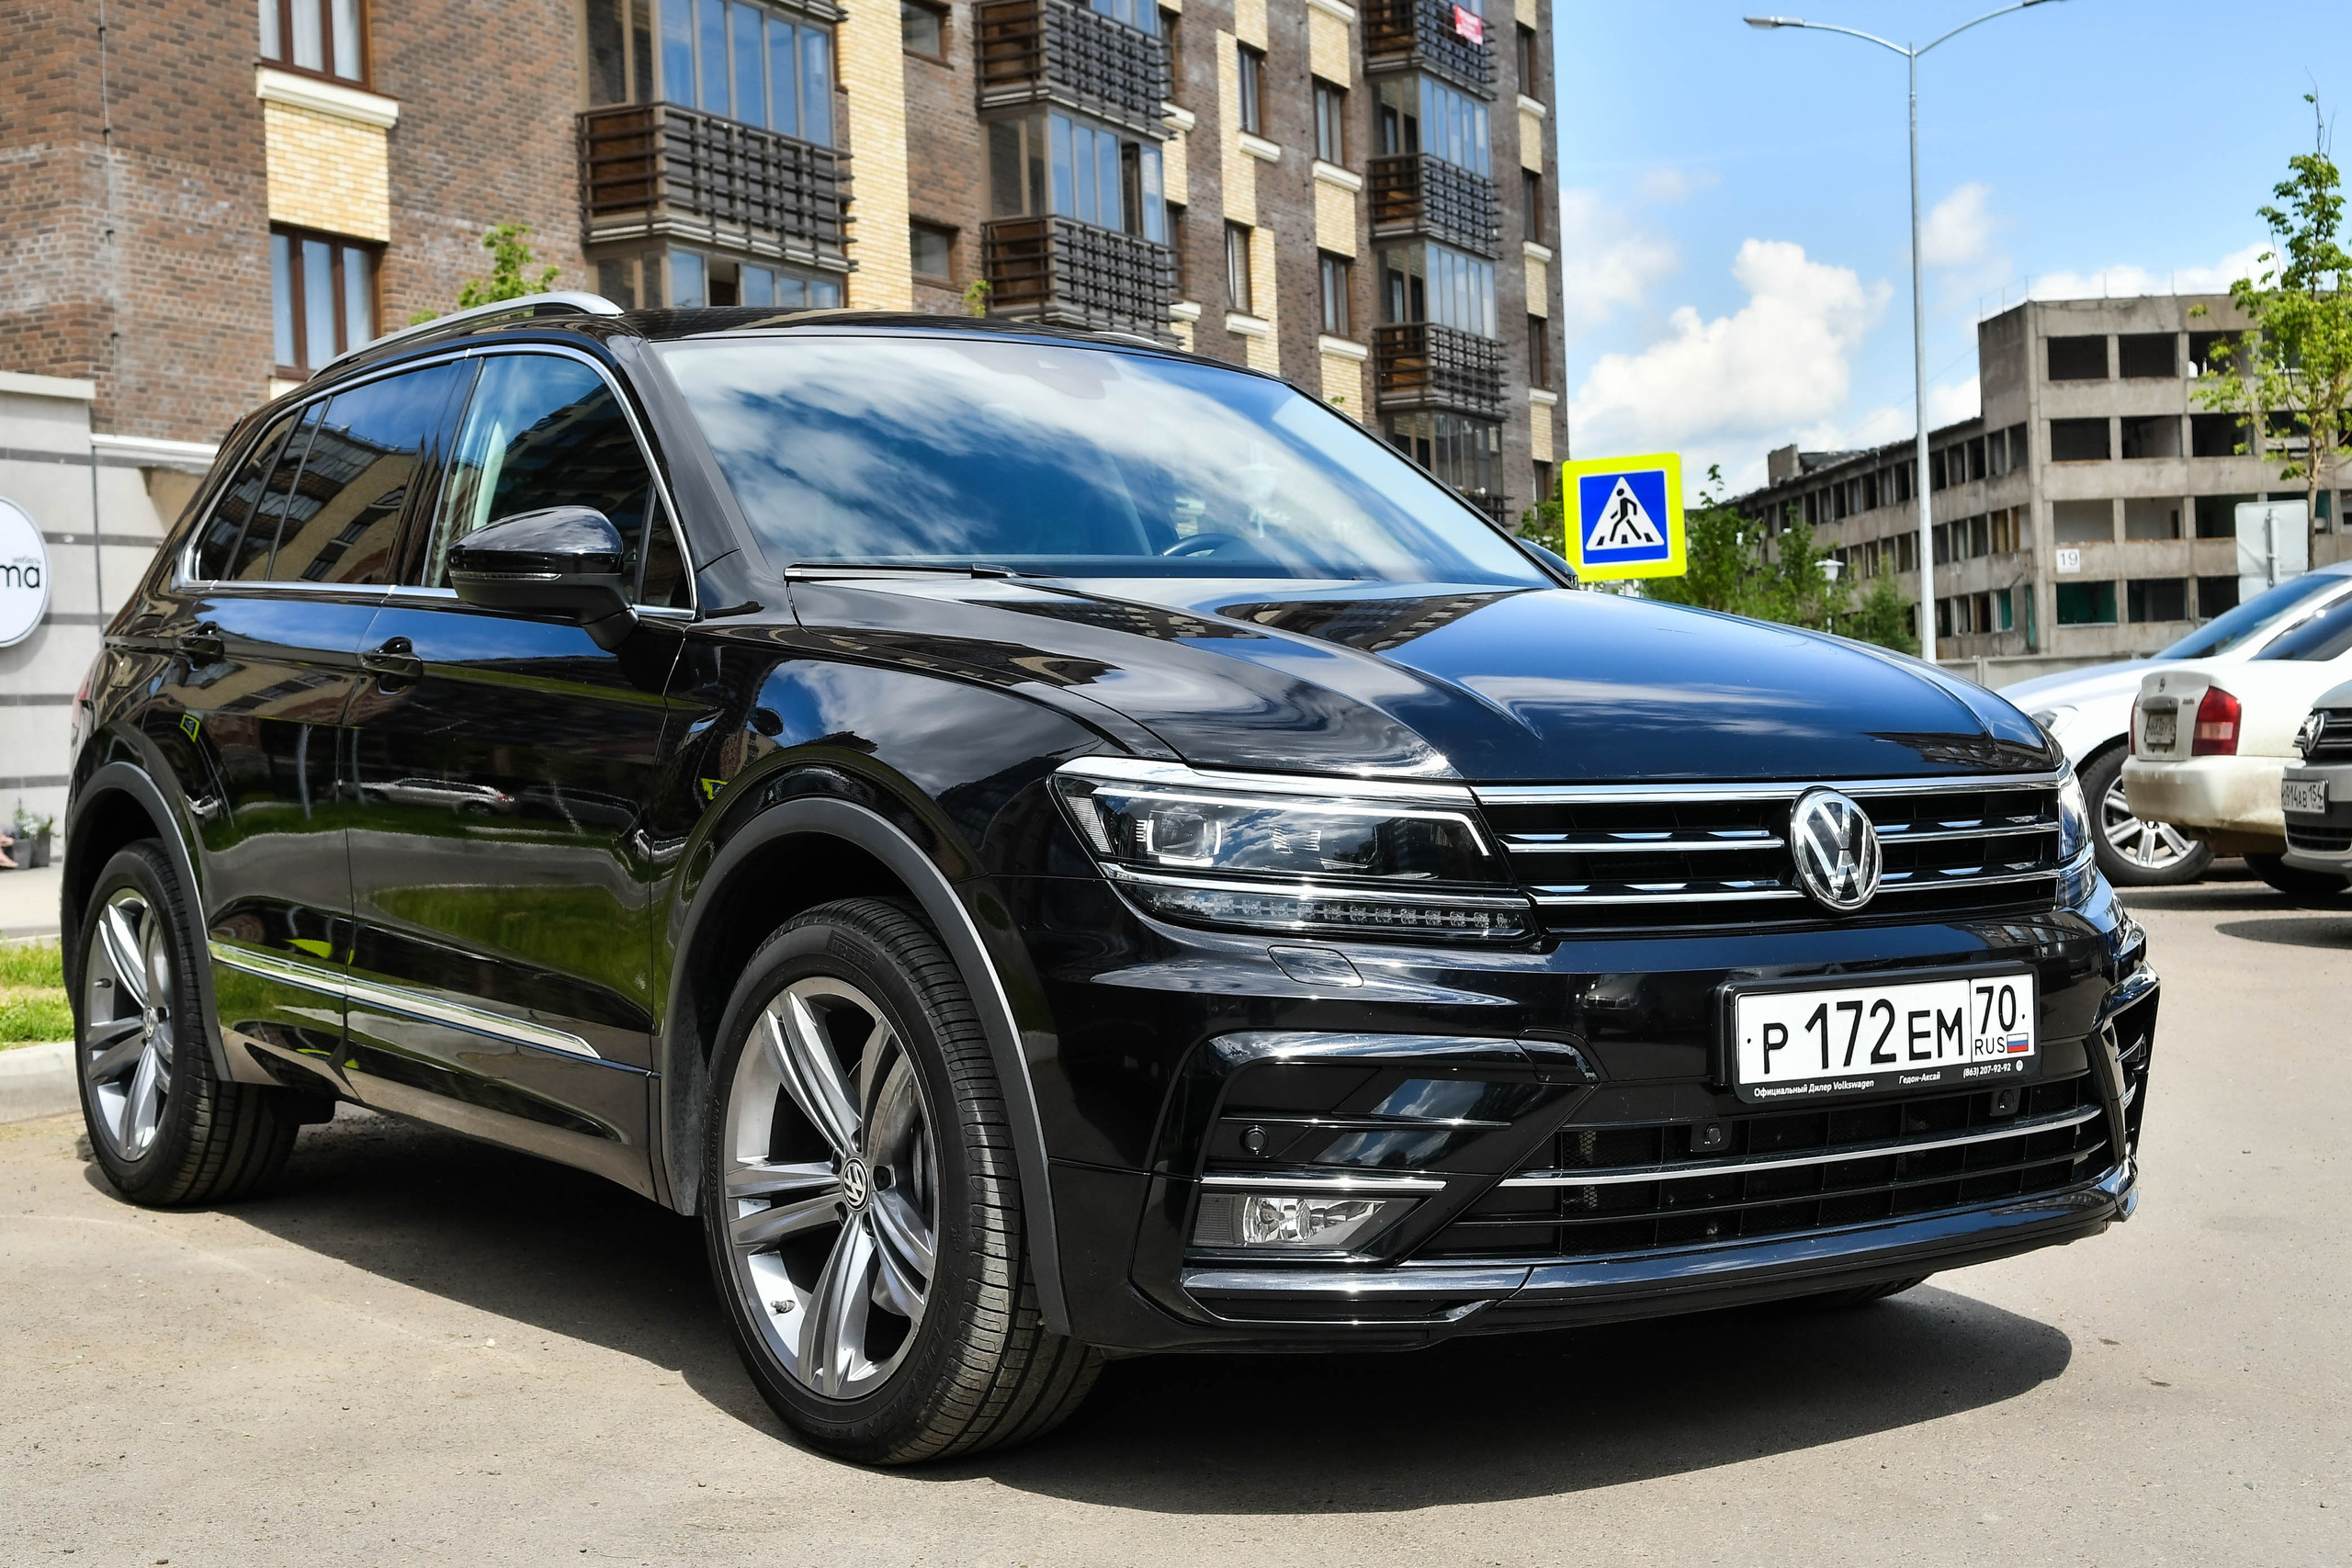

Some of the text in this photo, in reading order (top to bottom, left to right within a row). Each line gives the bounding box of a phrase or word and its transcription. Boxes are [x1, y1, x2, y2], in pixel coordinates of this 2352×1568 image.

[2061, 551, 2078, 566] 19
[2309, 784, 2324, 803] 154
[1975, 985, 2017, 1035] 70
[1975, 1037, 2006, 1055] RUS
[1899, 1071, 1941, 1085] Гедон-Аксай
[1980, 1063, 2012, 1076] 207-92-92
[1754, 1079, 1874, 1099] Официальный Дилер Volkswagen
